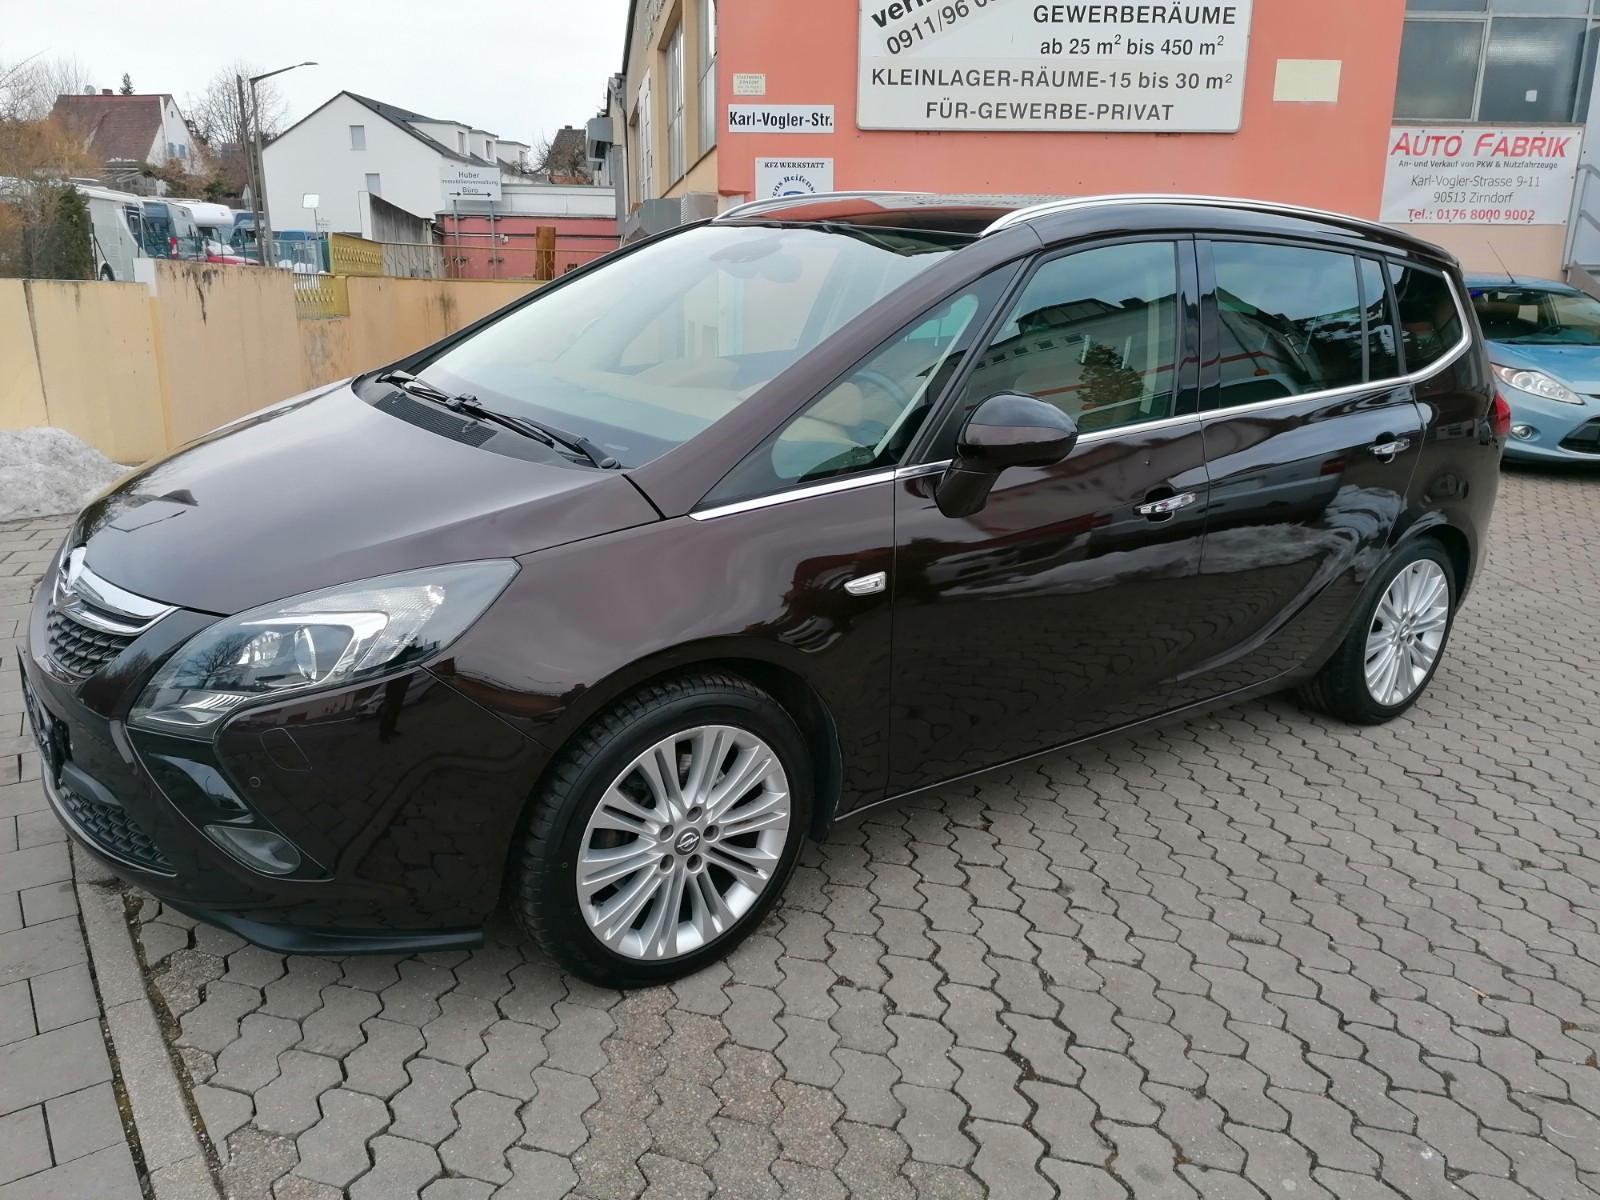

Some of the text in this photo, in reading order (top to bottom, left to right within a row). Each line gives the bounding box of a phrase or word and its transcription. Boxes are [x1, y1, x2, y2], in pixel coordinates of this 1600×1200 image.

[1033, 1, 1236, 24] GEWERBERÄUME
[1040, 38, 1063, 54] ab
[1069, 38, 1090, 55] 25
[1127, 38, 1154, 55] bis
[1160, 39, 1193, 56] 450
[872, 66, 1131, 88] KLEINLAGER-RÄUME-15
[1138, 72, 1169, 89] bis
[1175, 73, 1200, 89] 30
[926, 97, 1174, 121] FÜR-GEWERBE-PRIVAT
[729, 112, 833, 129] Karl-Vogler-Str.
[1473, 133, 1572, 158] FABRIK
[1430, 160, 1458, 169] Verkauf
[1476, 160, 1494, 169] PKW
[1503, 161, 1558, 170] Nutzfahrzeuge
[1411, 175, 1540, 188] Karl-Vogler-Strasse 9-11
[1433, 191, 1515, 203] 90513 Zirndorf
[1407, 208, 1536, 221] Tel.: 0176 8000 9002
